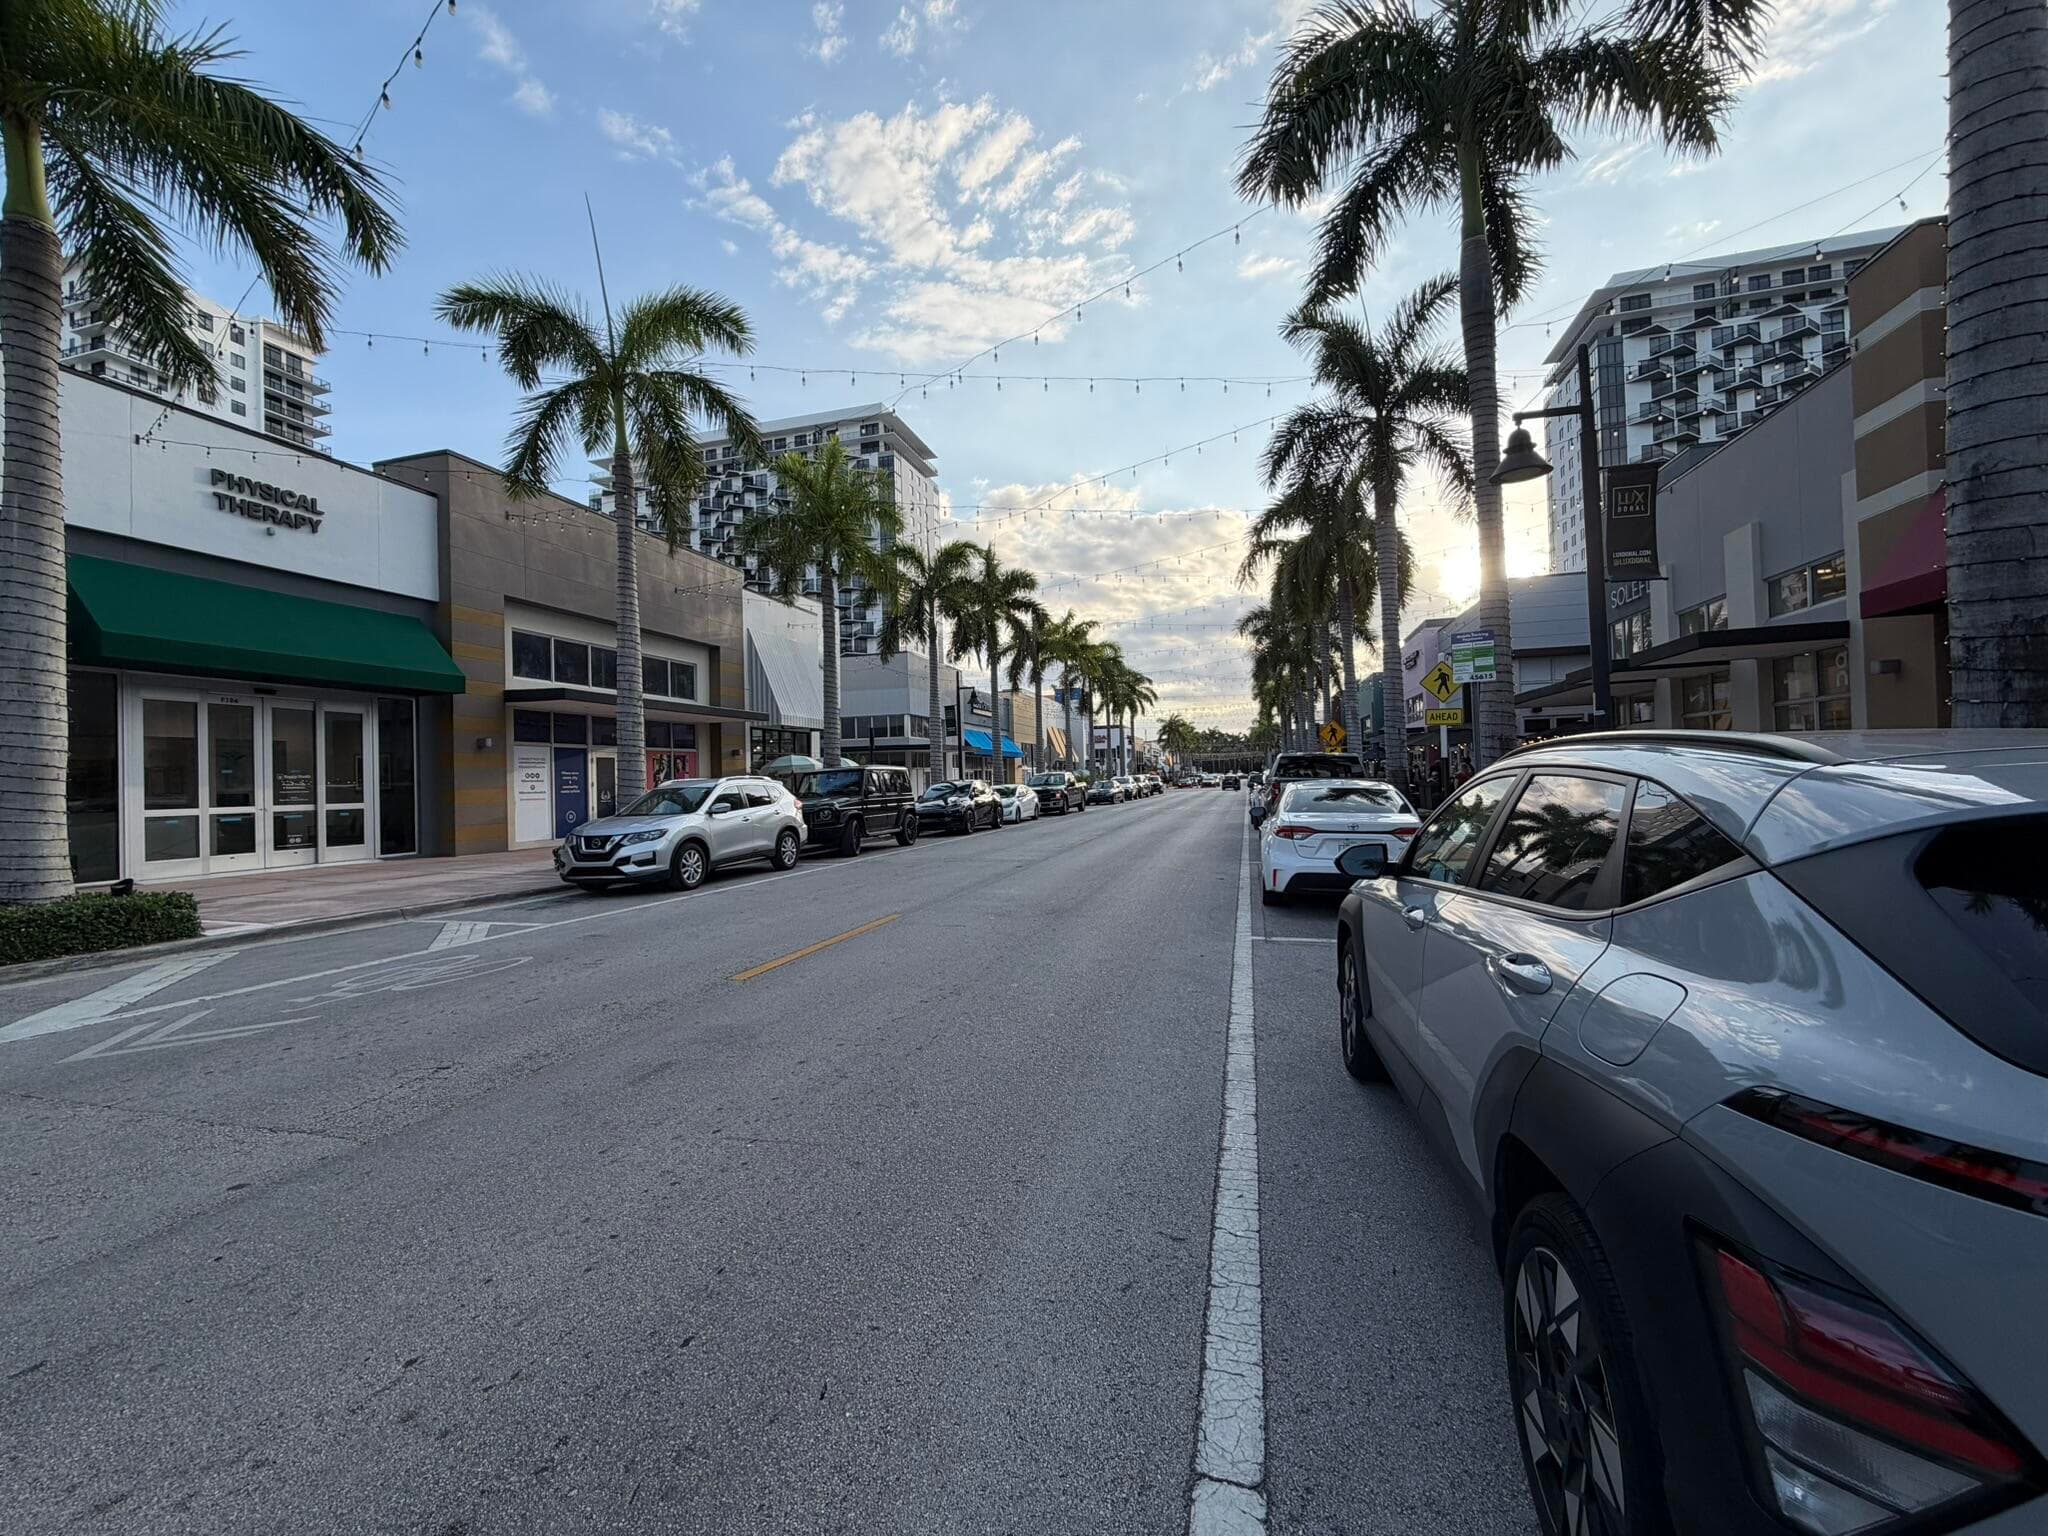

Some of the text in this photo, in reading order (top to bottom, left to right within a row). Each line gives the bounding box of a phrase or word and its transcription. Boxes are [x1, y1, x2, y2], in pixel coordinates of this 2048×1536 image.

[210, 468, 325, 516] PHYSICAL
[1617, 489, 1646, 505] LUX
[212, 491, 322, 534] THERAPY
[1617, 504, 1645, 513] DORAL
[1429, 712, 1458, 721] AHEAD
